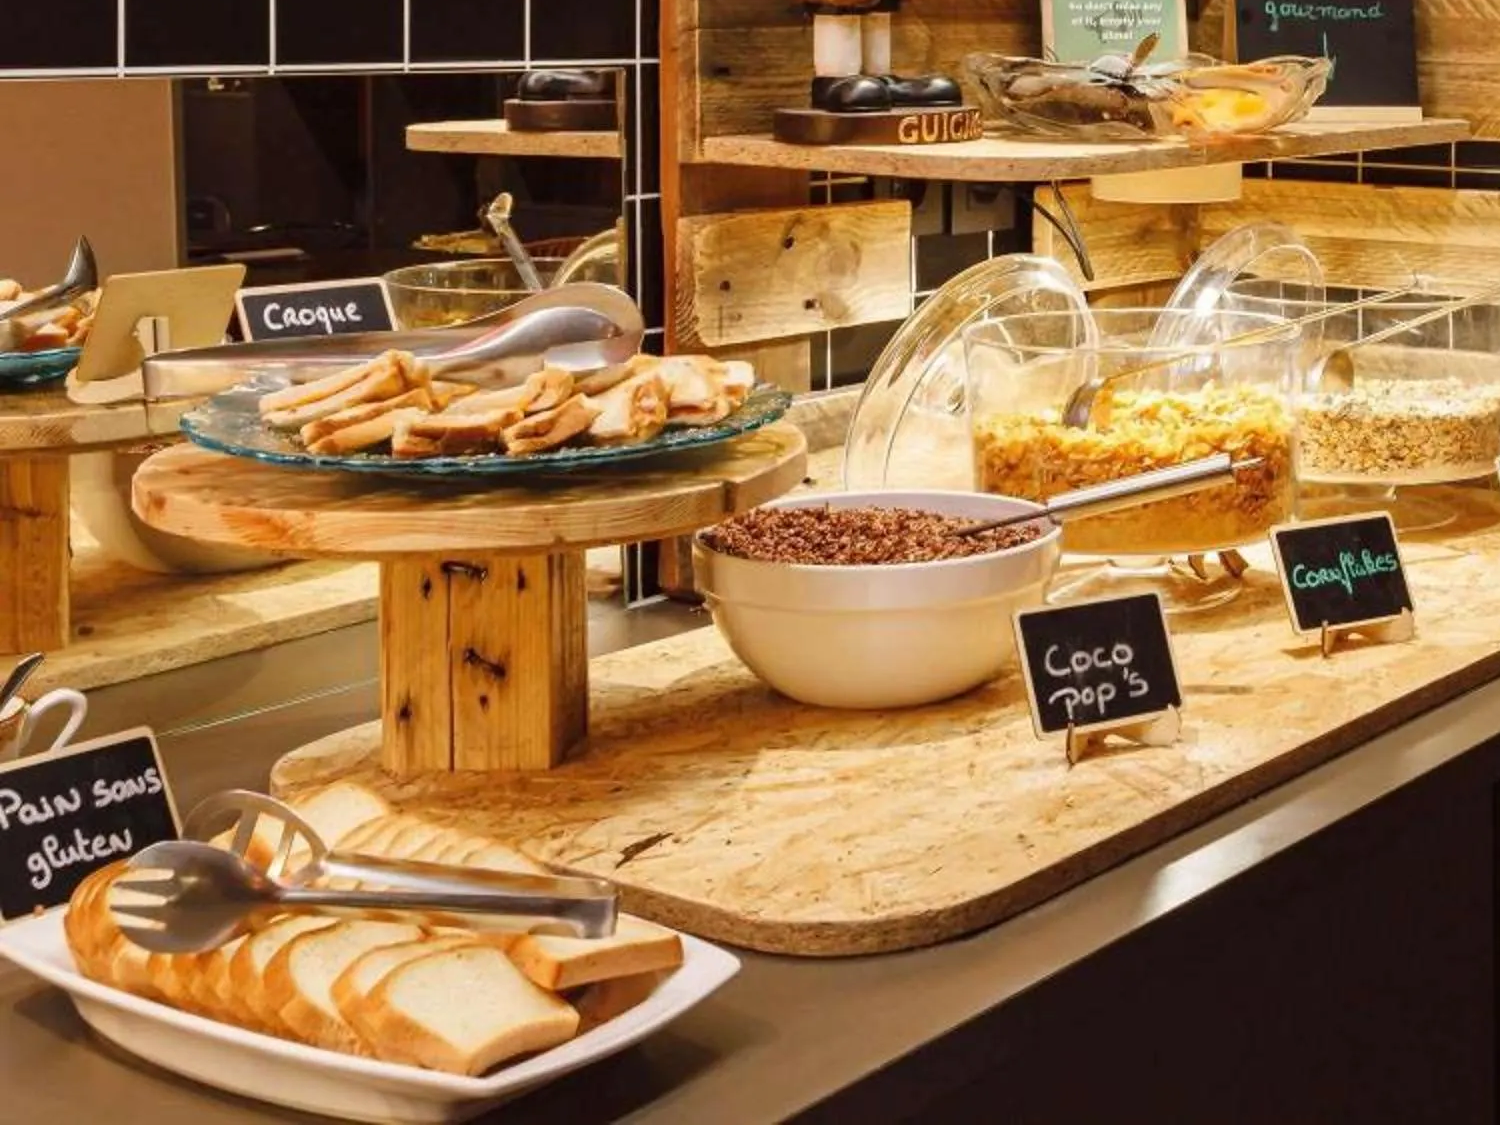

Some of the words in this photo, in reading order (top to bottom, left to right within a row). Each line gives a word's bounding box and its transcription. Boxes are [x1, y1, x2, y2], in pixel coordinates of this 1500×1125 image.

[1265, 1, 1385, 32] gourmand
[263, 301, 363, 335] Croque
[1293, 548, 1399, 595] Cornflakes
[1044, 643, 1134, 677] Coco
[1048, 667, 1150, 721] pop's
[0, 787, 82, 831] Pain
[92, 767, 164, 809] sans
[27, 827, 133, 891] gluten
